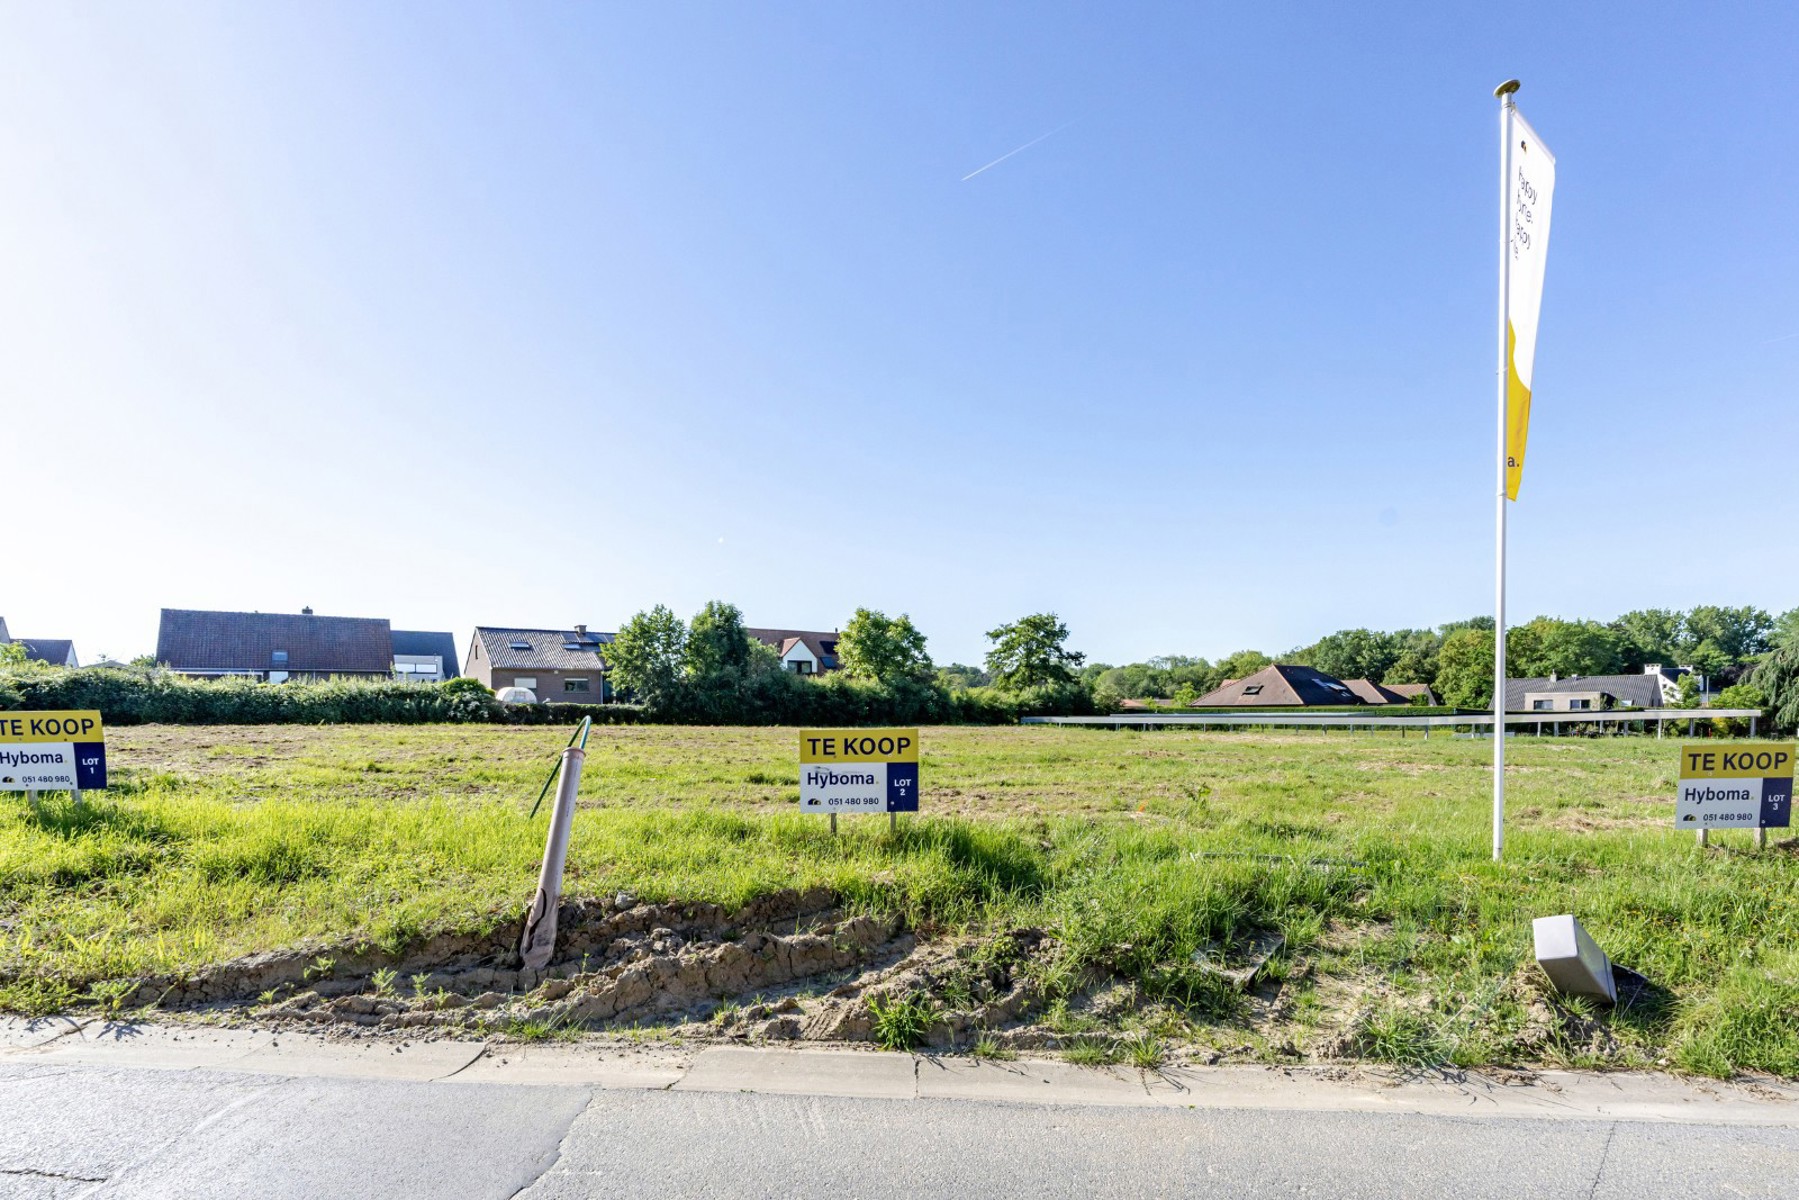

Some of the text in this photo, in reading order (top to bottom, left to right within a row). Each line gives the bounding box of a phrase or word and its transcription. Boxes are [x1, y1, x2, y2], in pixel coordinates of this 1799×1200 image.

[0, 718, 94, 736] TE KOOP
[807, 737, 911, 756] TE KOOP
[82, 758, 99, 766] LOT
[1688, 752, 1788, 771] TE KOOP
[894, 779, 912, 787] LOT
[900, 788, 906, 796] 2
[828, 798, 843, 806] 051
[863, 797, 879, 805] 980
[1768, 794, 1785, 803] LOT
[1772, 803, 1779, 811] 3
[1702, 813, 1753, 821] 051 480 980
